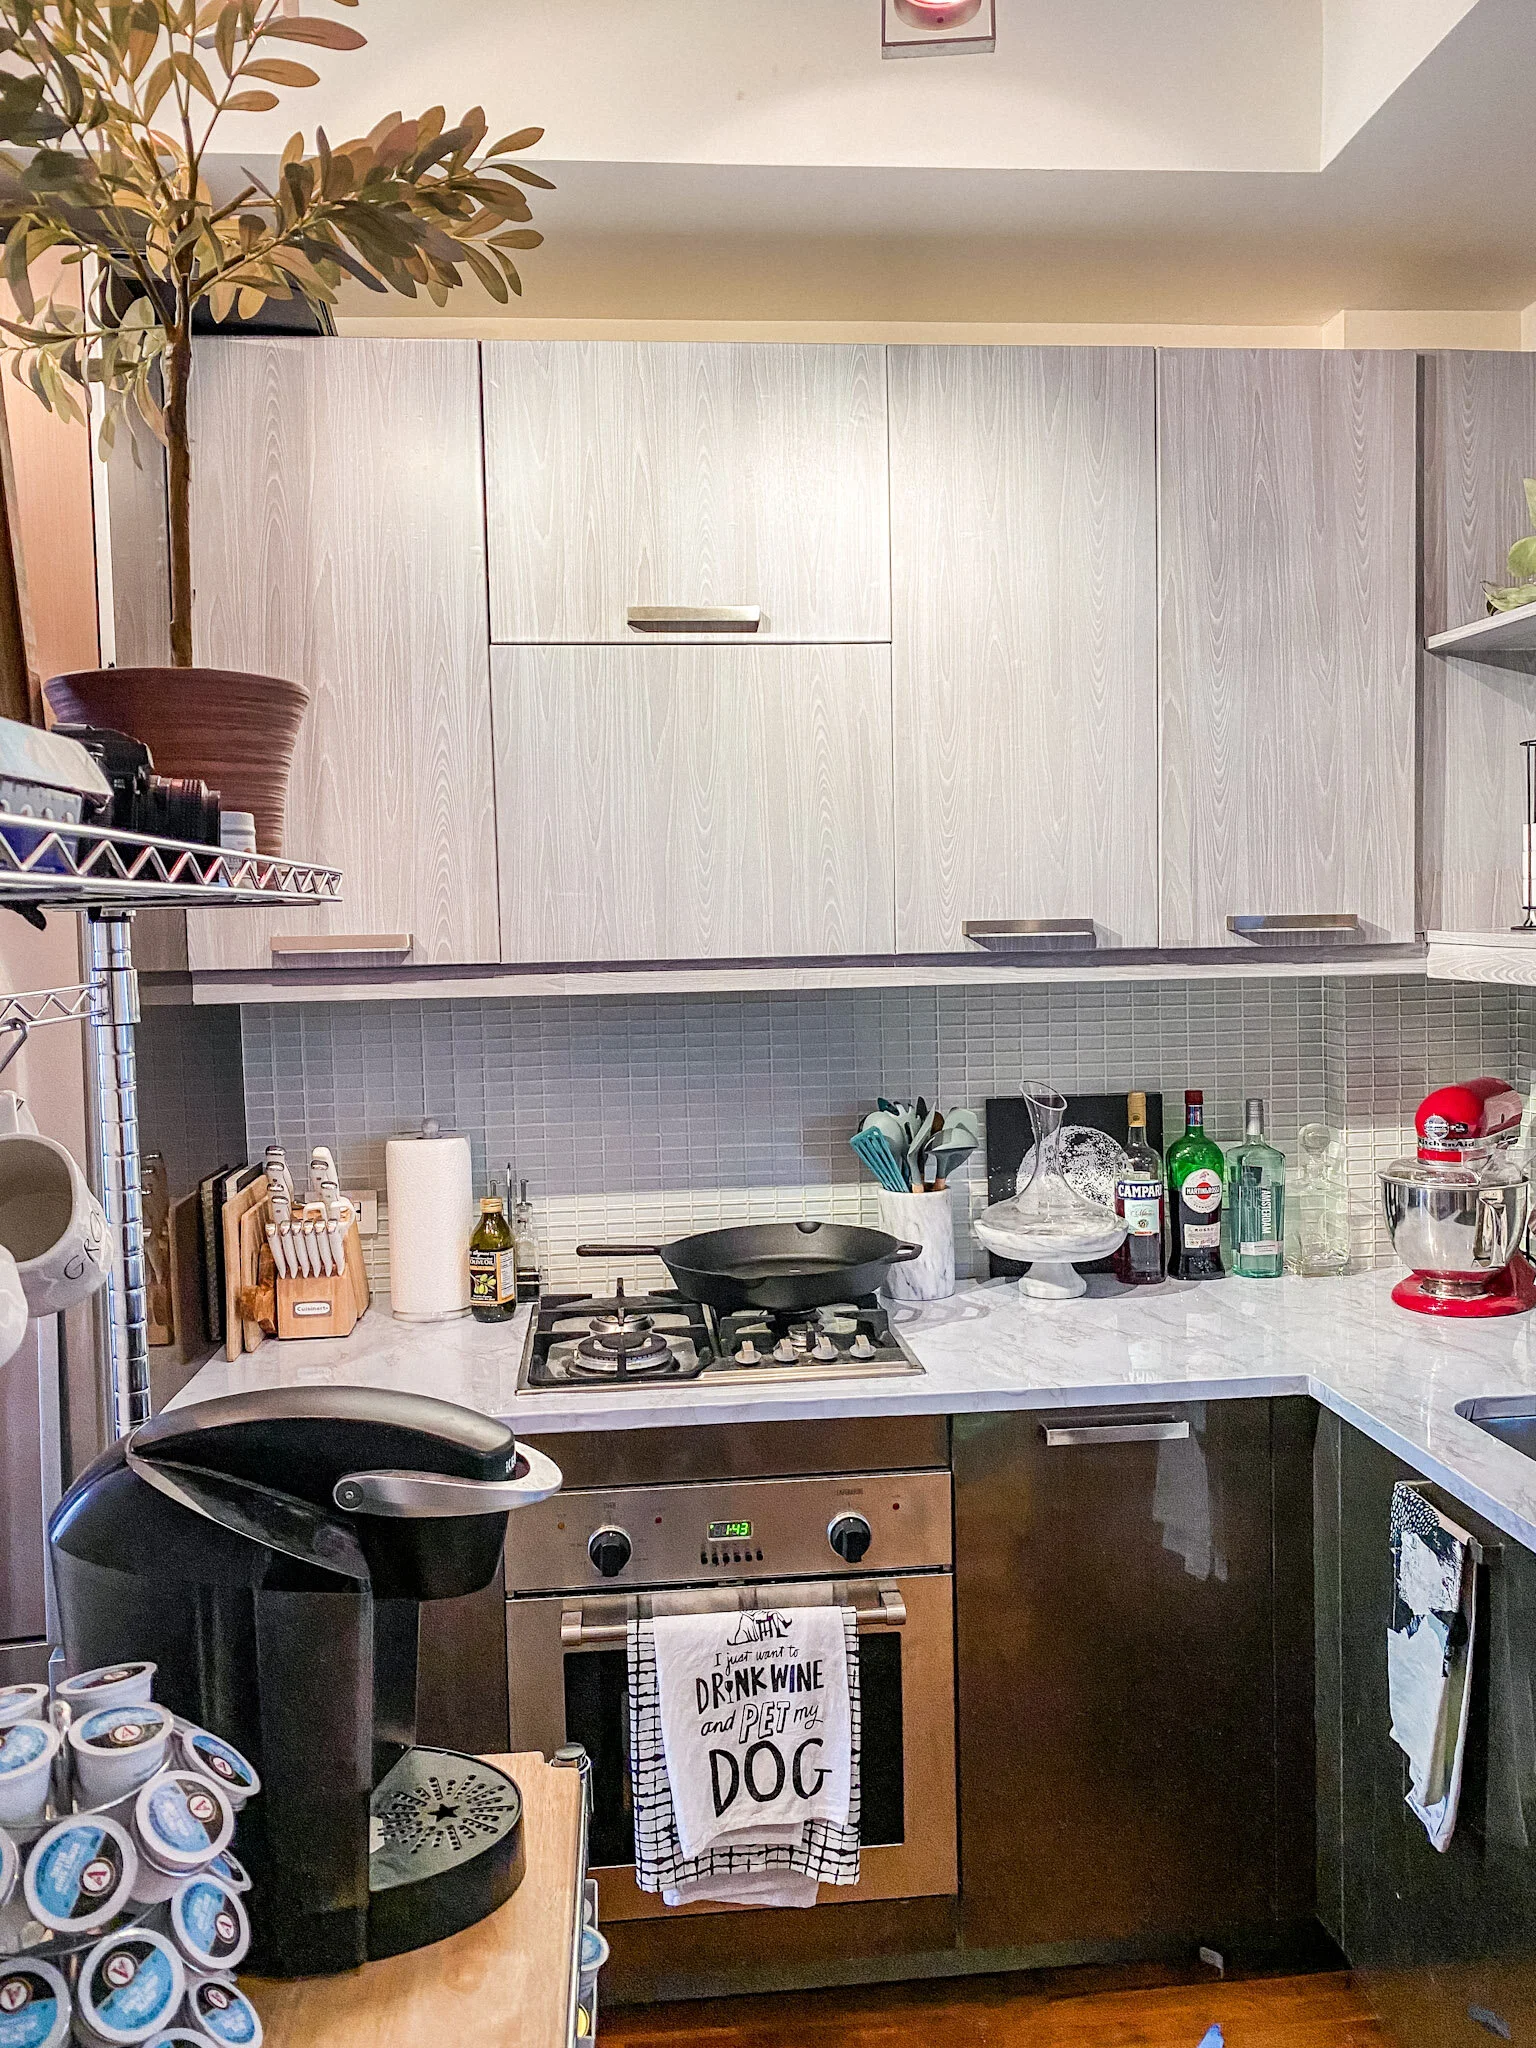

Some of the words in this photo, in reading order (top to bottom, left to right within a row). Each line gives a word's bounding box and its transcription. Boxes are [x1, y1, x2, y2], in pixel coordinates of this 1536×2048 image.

[1417, 1138, 1475, 1147] KitchenAid
[1118, 1184, 1162, 1198] CAMPARI
[1261, 1189, 1271, 1234] AMSTERDAM
[714, 1652, 722, 1667] I
[724, 1651, 753, 1677] just
[755, 1645, 785, 1661] want
[786, 1644, 800, 1658] to
[696, 1666, 768, 1715] DRINK
[770, 1659, 825, 1693] WINE
[700, 1709, 737, 1737] and
[738, 1700, 791, 1743] PET
[793, 1704, 824, 1730] my
[708, 1737, 833, 1818] DOG
